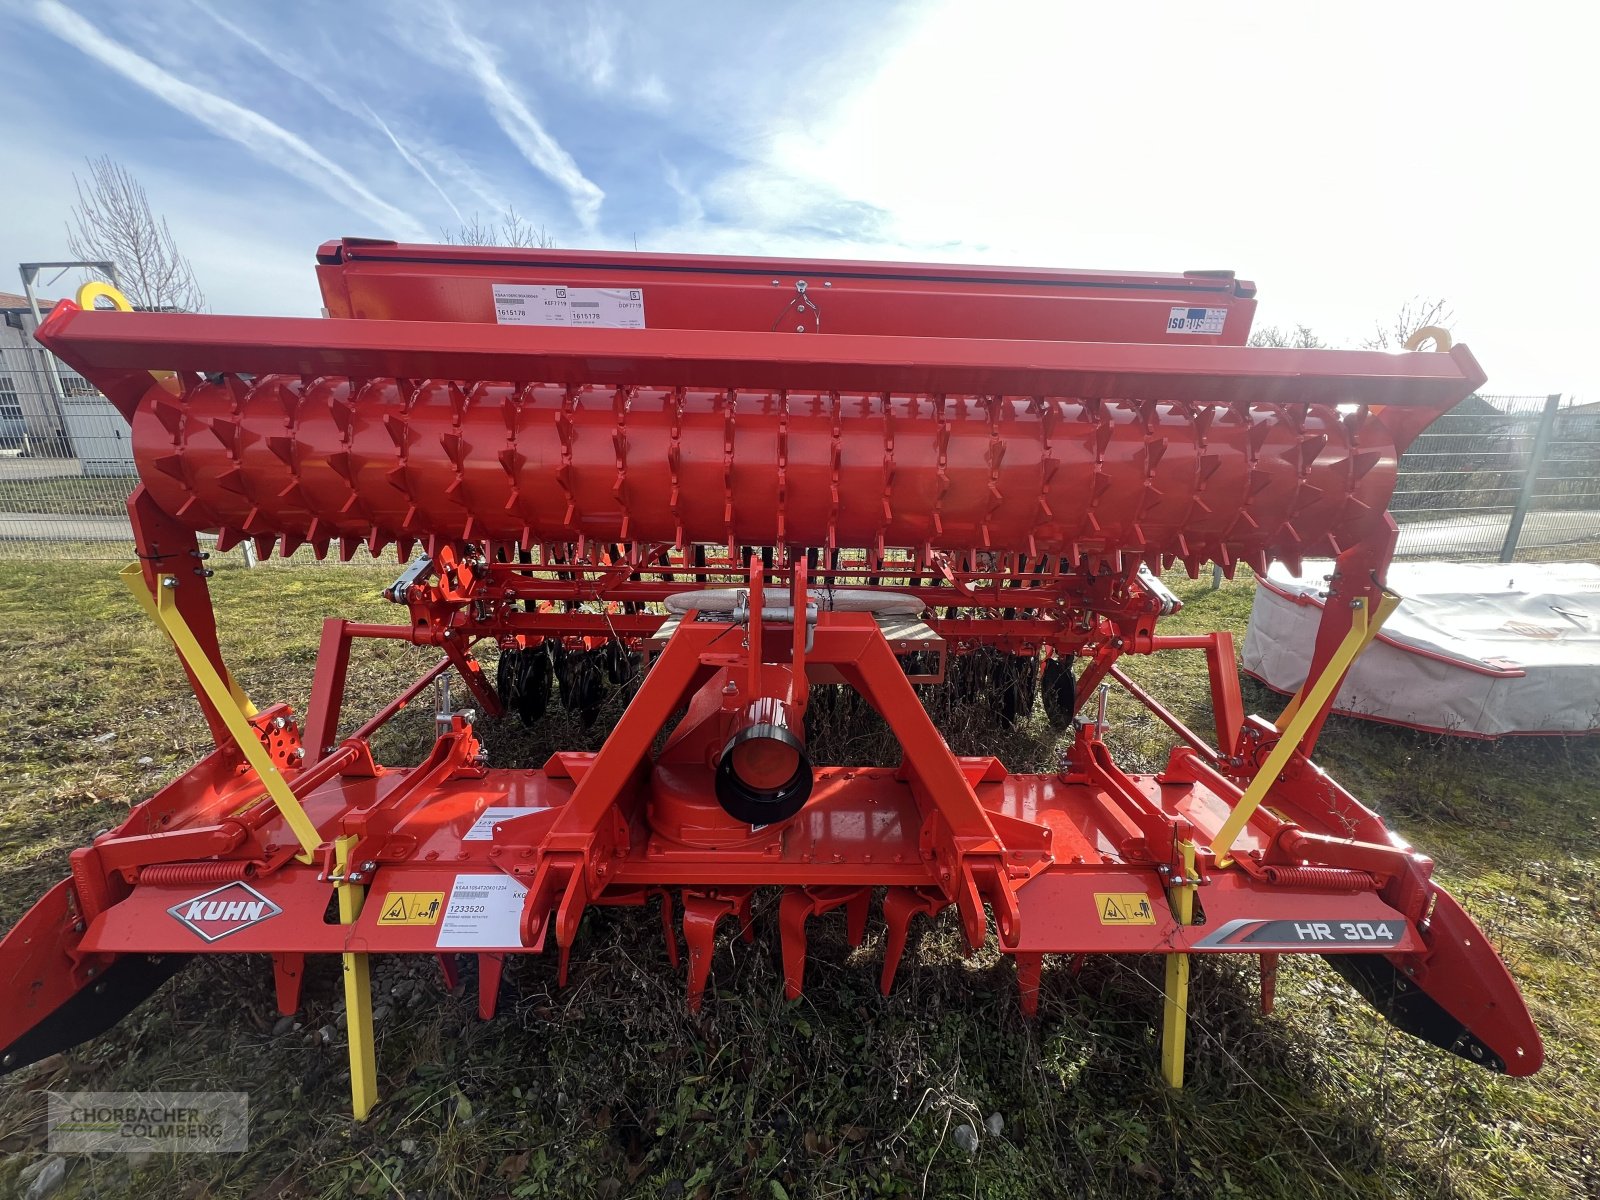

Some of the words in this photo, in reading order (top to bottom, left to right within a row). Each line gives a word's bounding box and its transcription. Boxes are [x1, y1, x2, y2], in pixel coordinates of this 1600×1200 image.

[184, 901, 265, 921] KUHN
[450, 905, 485, 913] 1233520
[1294, 922, 1335, 940] HR
[1341, 923, 1394, 940] 304
